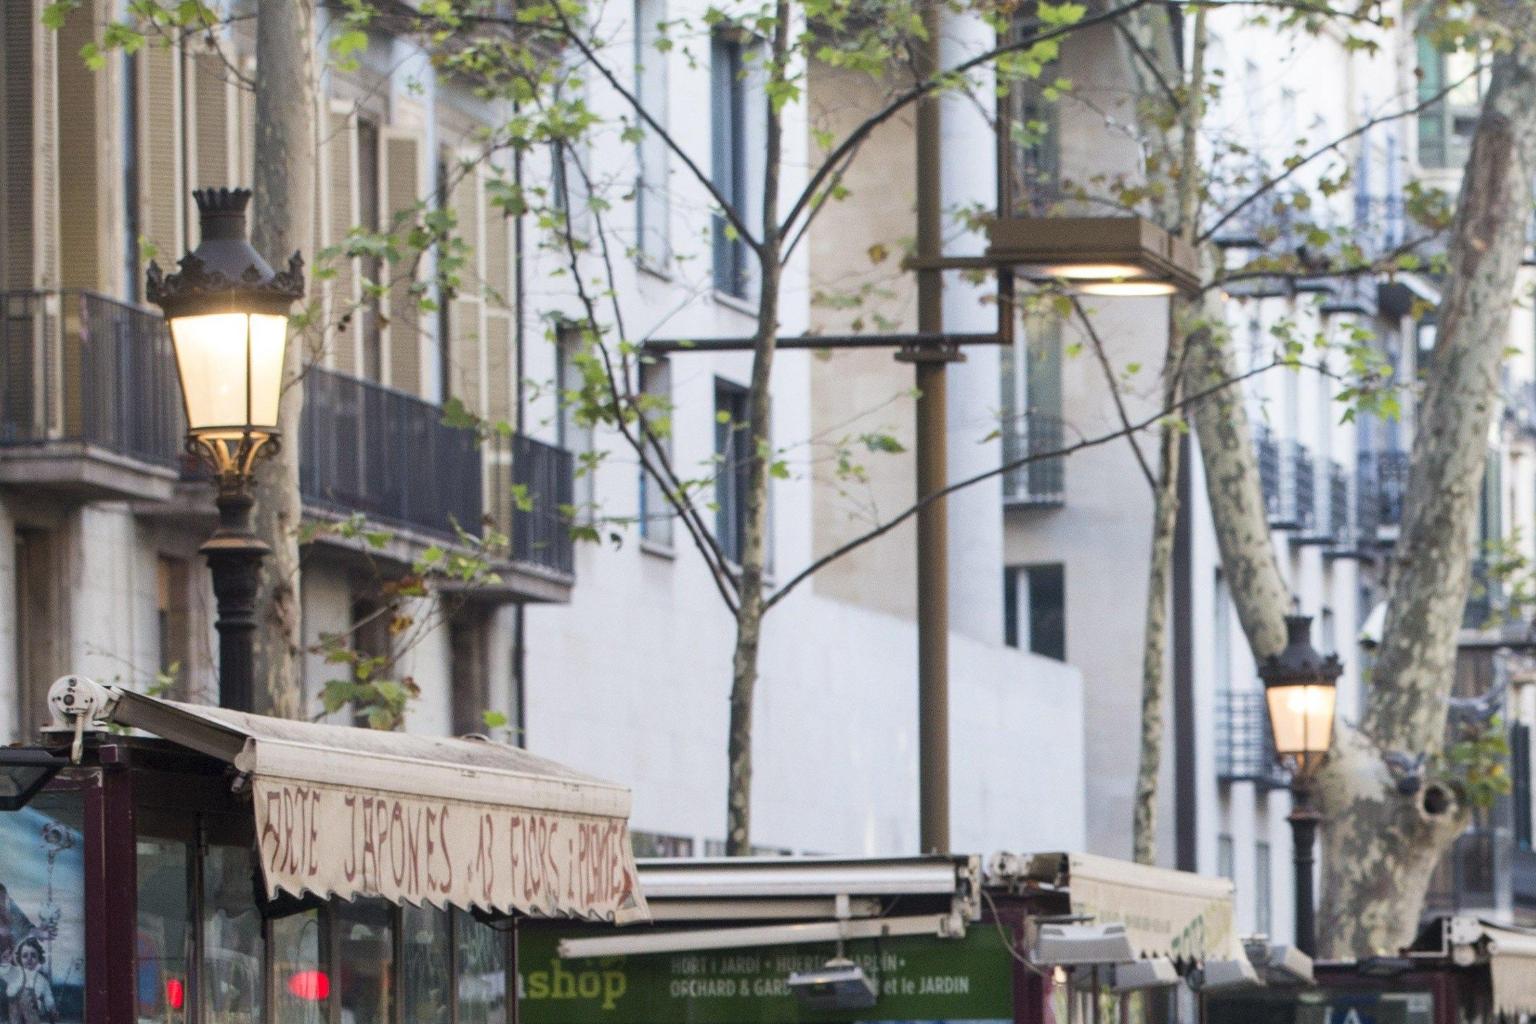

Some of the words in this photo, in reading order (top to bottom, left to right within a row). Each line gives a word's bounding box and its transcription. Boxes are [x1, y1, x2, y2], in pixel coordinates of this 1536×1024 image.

[262, 787, 321, 876] ARTE
[344, 796, 453, 894] JAPONES
[670, 978, 736, 998] ORCHARD
[919, 975, 969, 995] JARDIN
